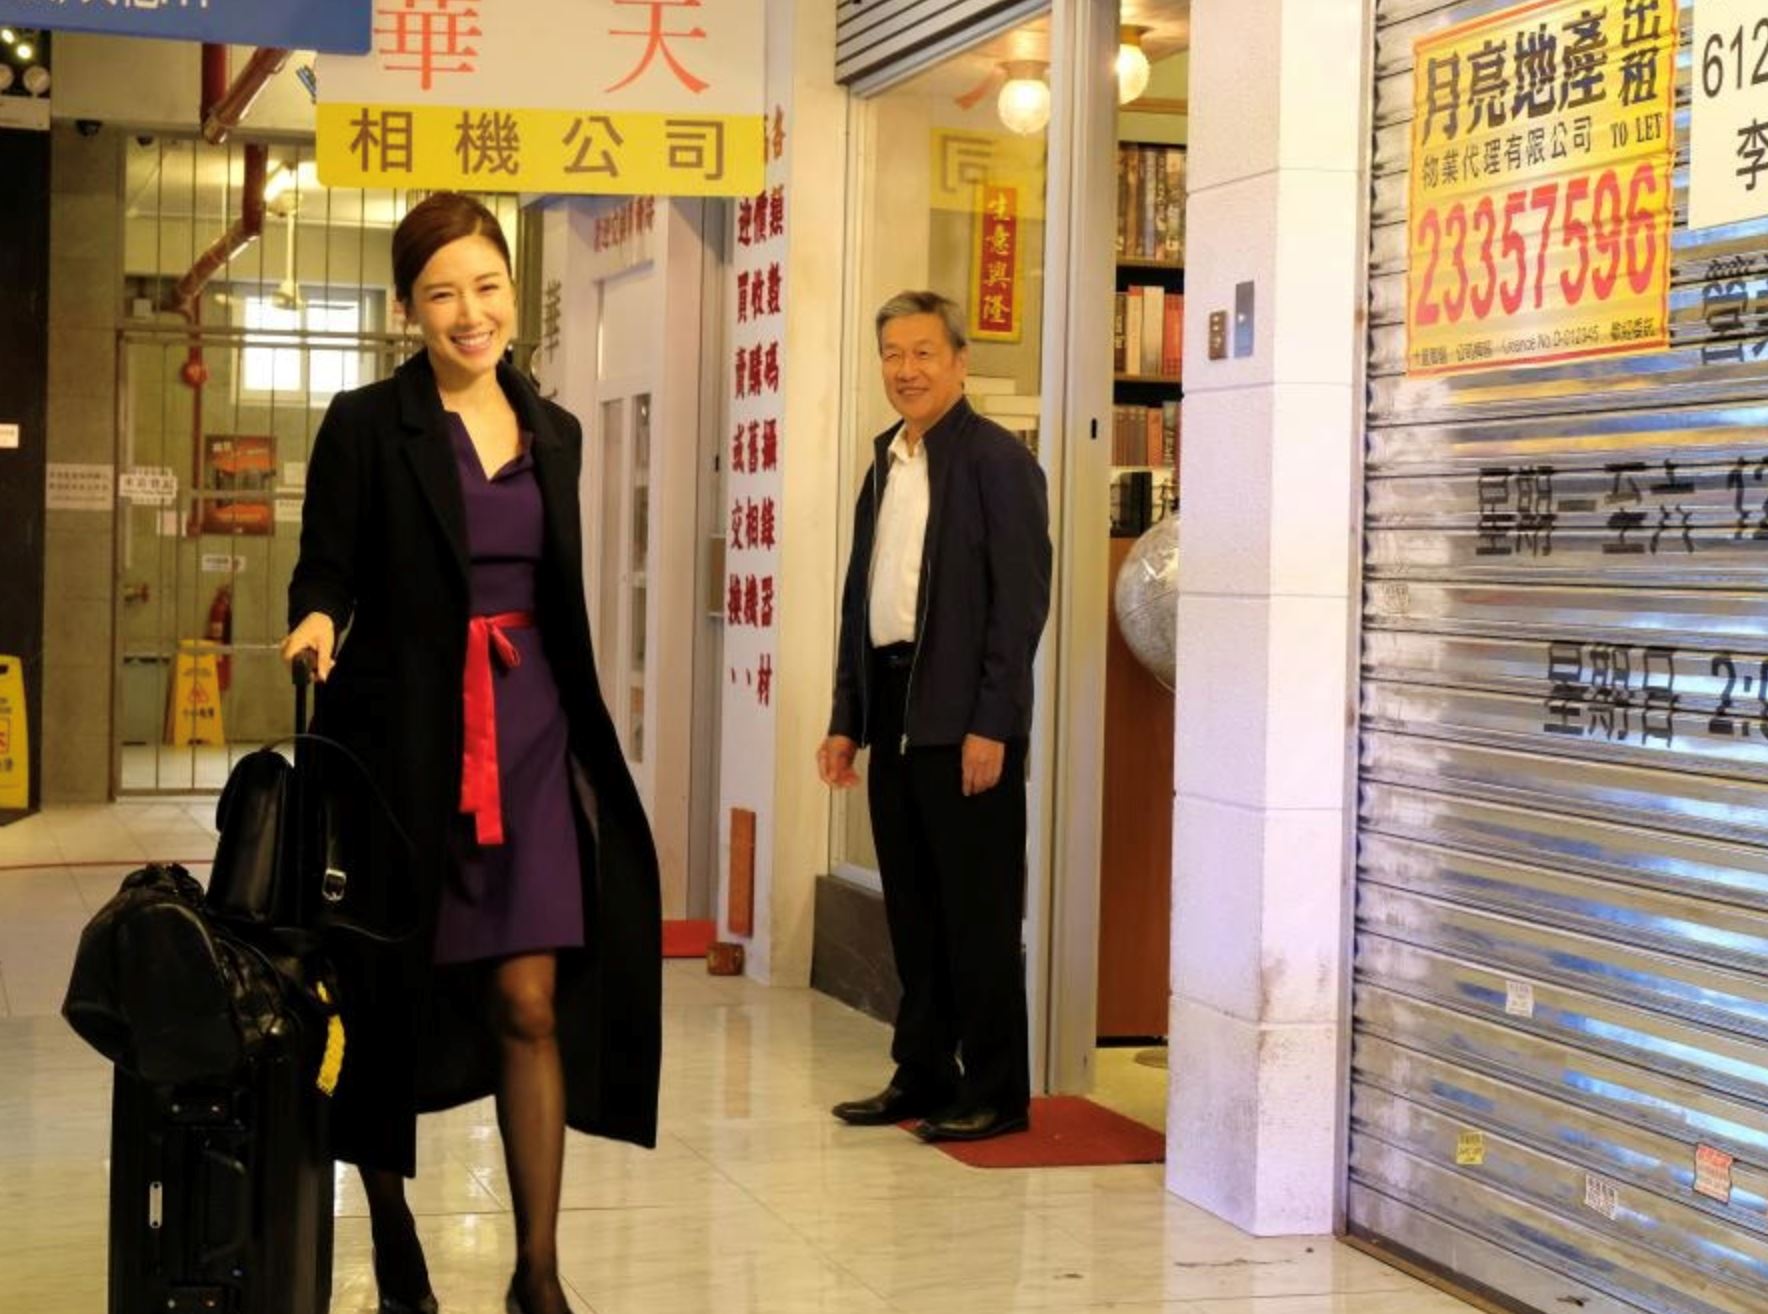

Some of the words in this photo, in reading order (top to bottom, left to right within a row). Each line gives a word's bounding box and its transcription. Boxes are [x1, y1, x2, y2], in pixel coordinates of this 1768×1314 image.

[1422, 8, 1607, 146] 月亮地產
[1617, 0, 1661, 107] 出租
[349, 106, 725, 182] 相機公司
[1423, 114, 1592, 191] 物業代理有限公司
[1611, 121, 1628, 149] TO
[1636, 112, 1663, 144] LET
[1736, 118, 1768, 190] 李
[982, 191, 1012, 323] 生意興隆
[1415, 162, 1658, 326] 23357596
[1475, 458, 1695, 557] 星期一至六
[1543, 640, 1679, 749] 星期日
